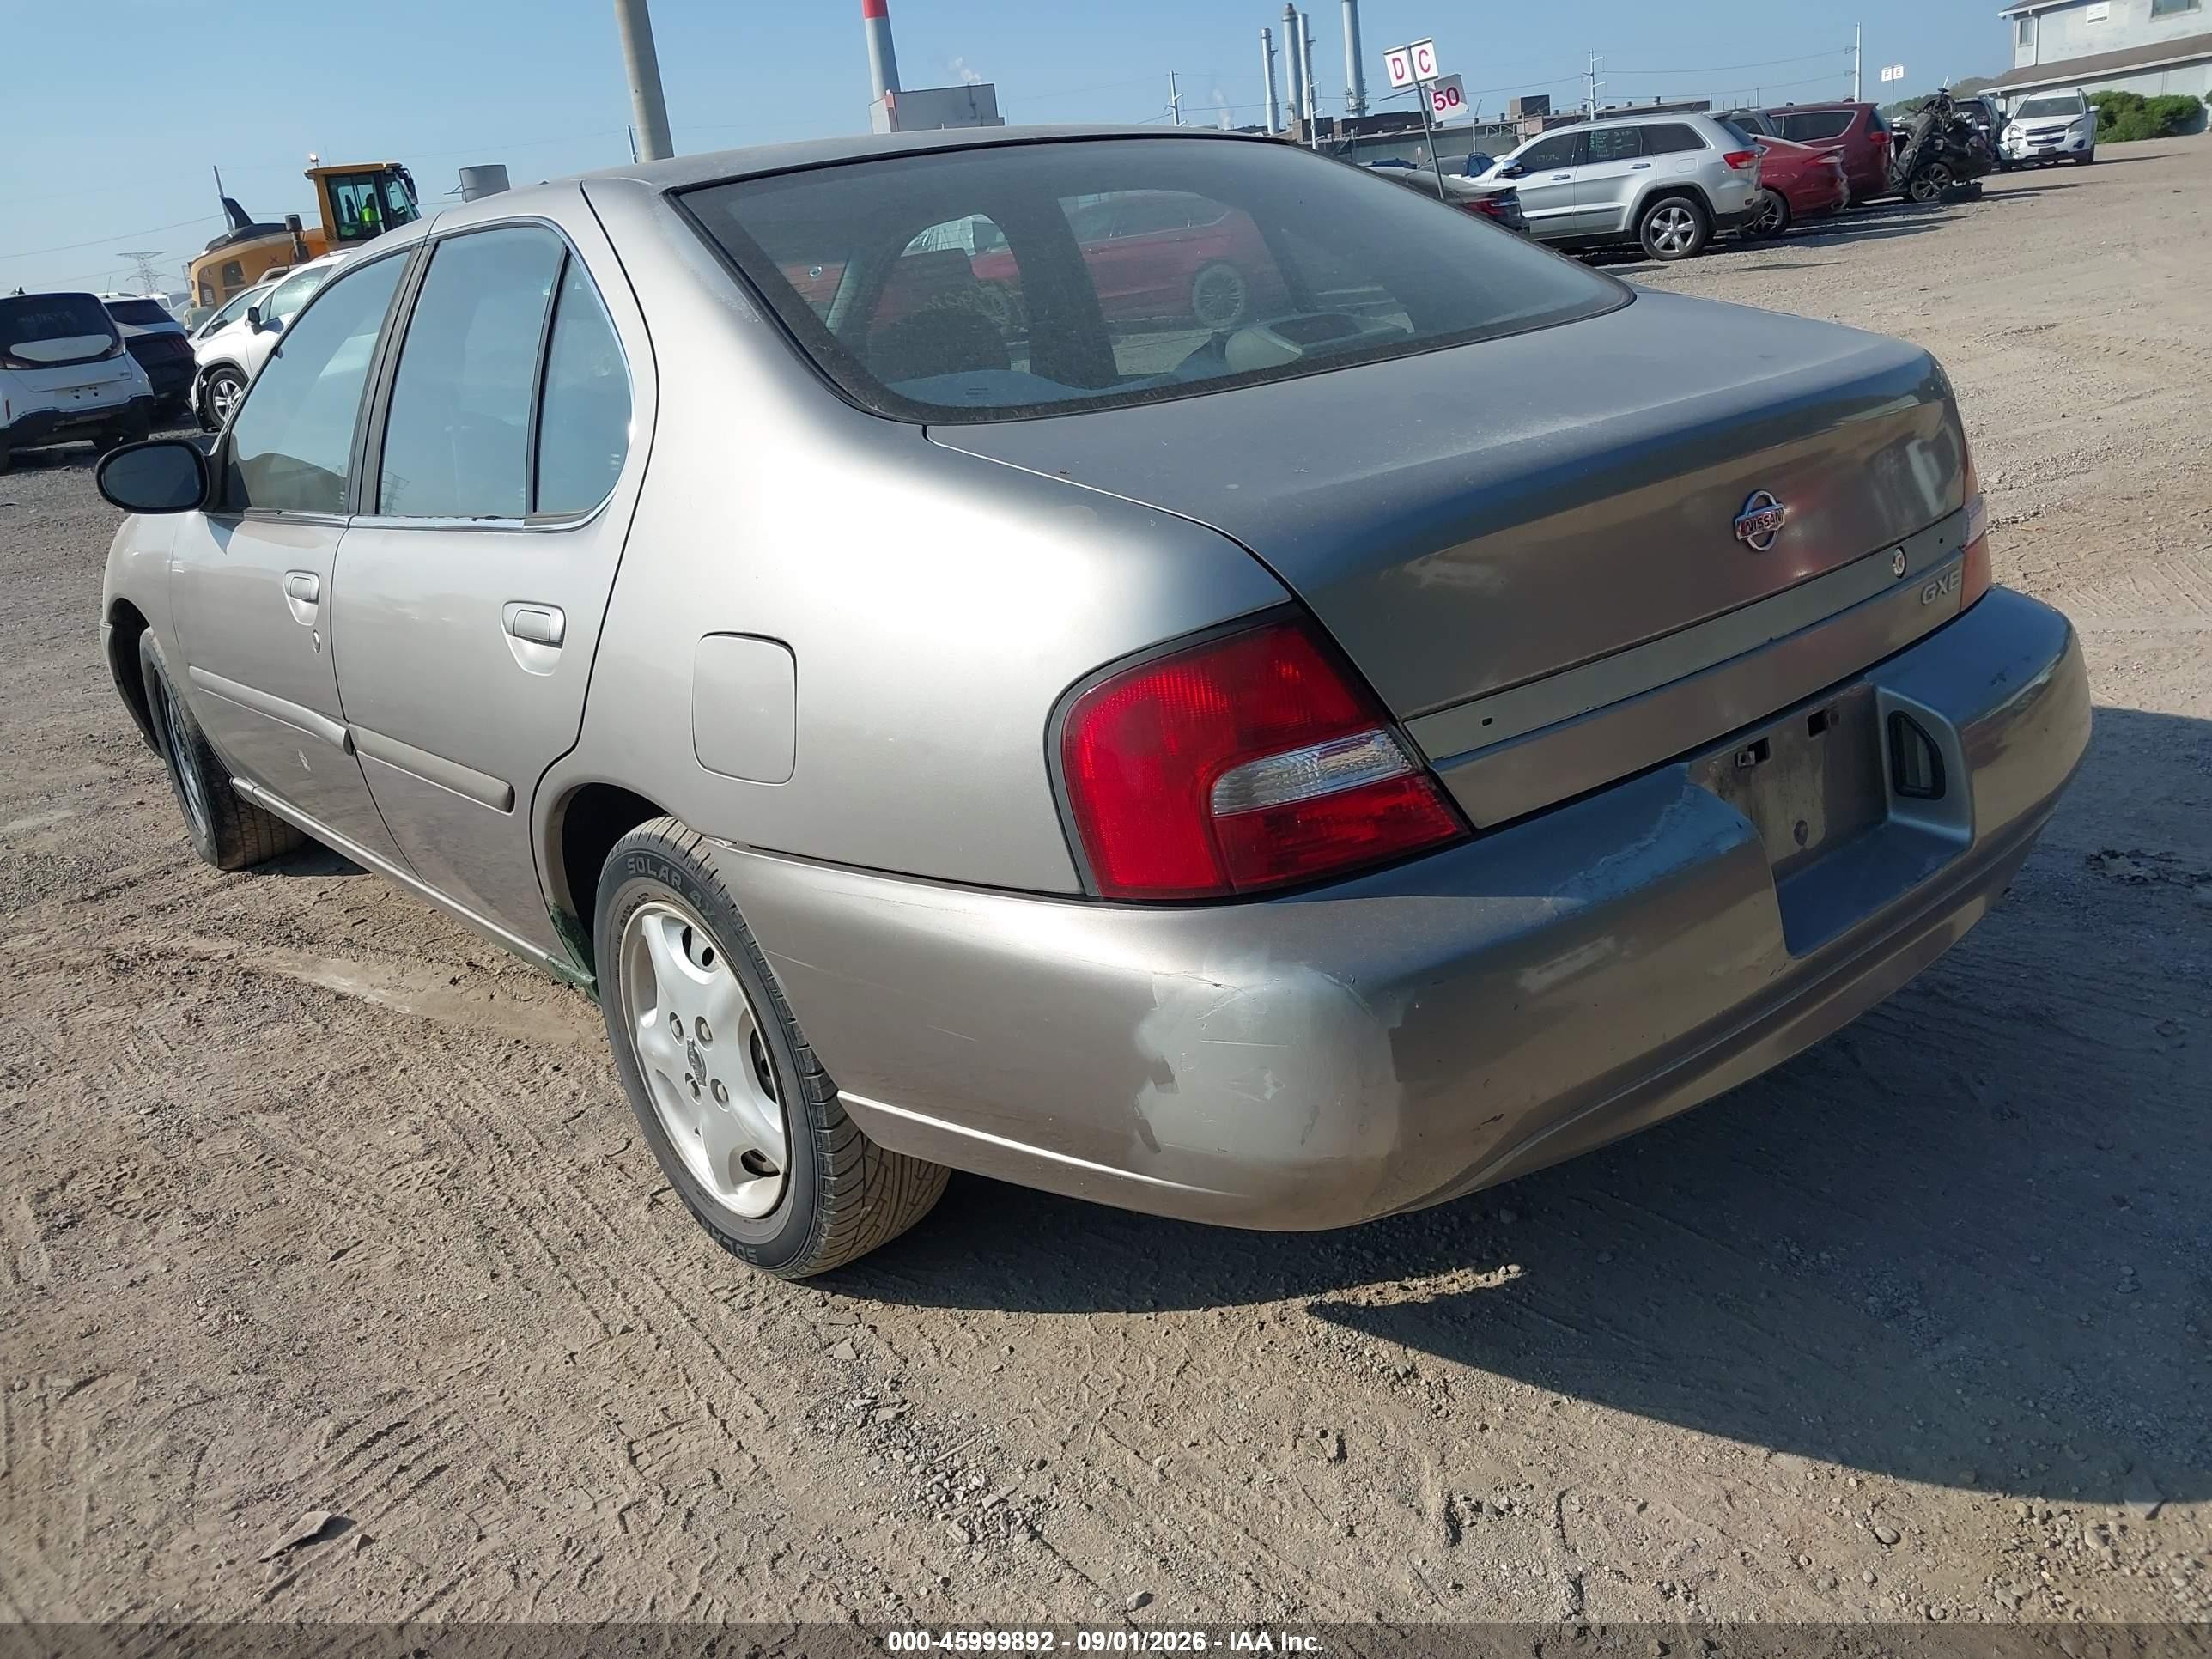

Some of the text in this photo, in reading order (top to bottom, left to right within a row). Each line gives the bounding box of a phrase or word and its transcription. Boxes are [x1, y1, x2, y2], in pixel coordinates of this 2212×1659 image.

[1391, 57, 1405, 80] D
[1418, 49, 1431, 73] C
[1432, 87, 1460, 111] 50
[1744, 508, 1784, 533] NISSAN
[1921, 570, 1959, 605] GXE
[627, 857, 682, 891] SOLAR
